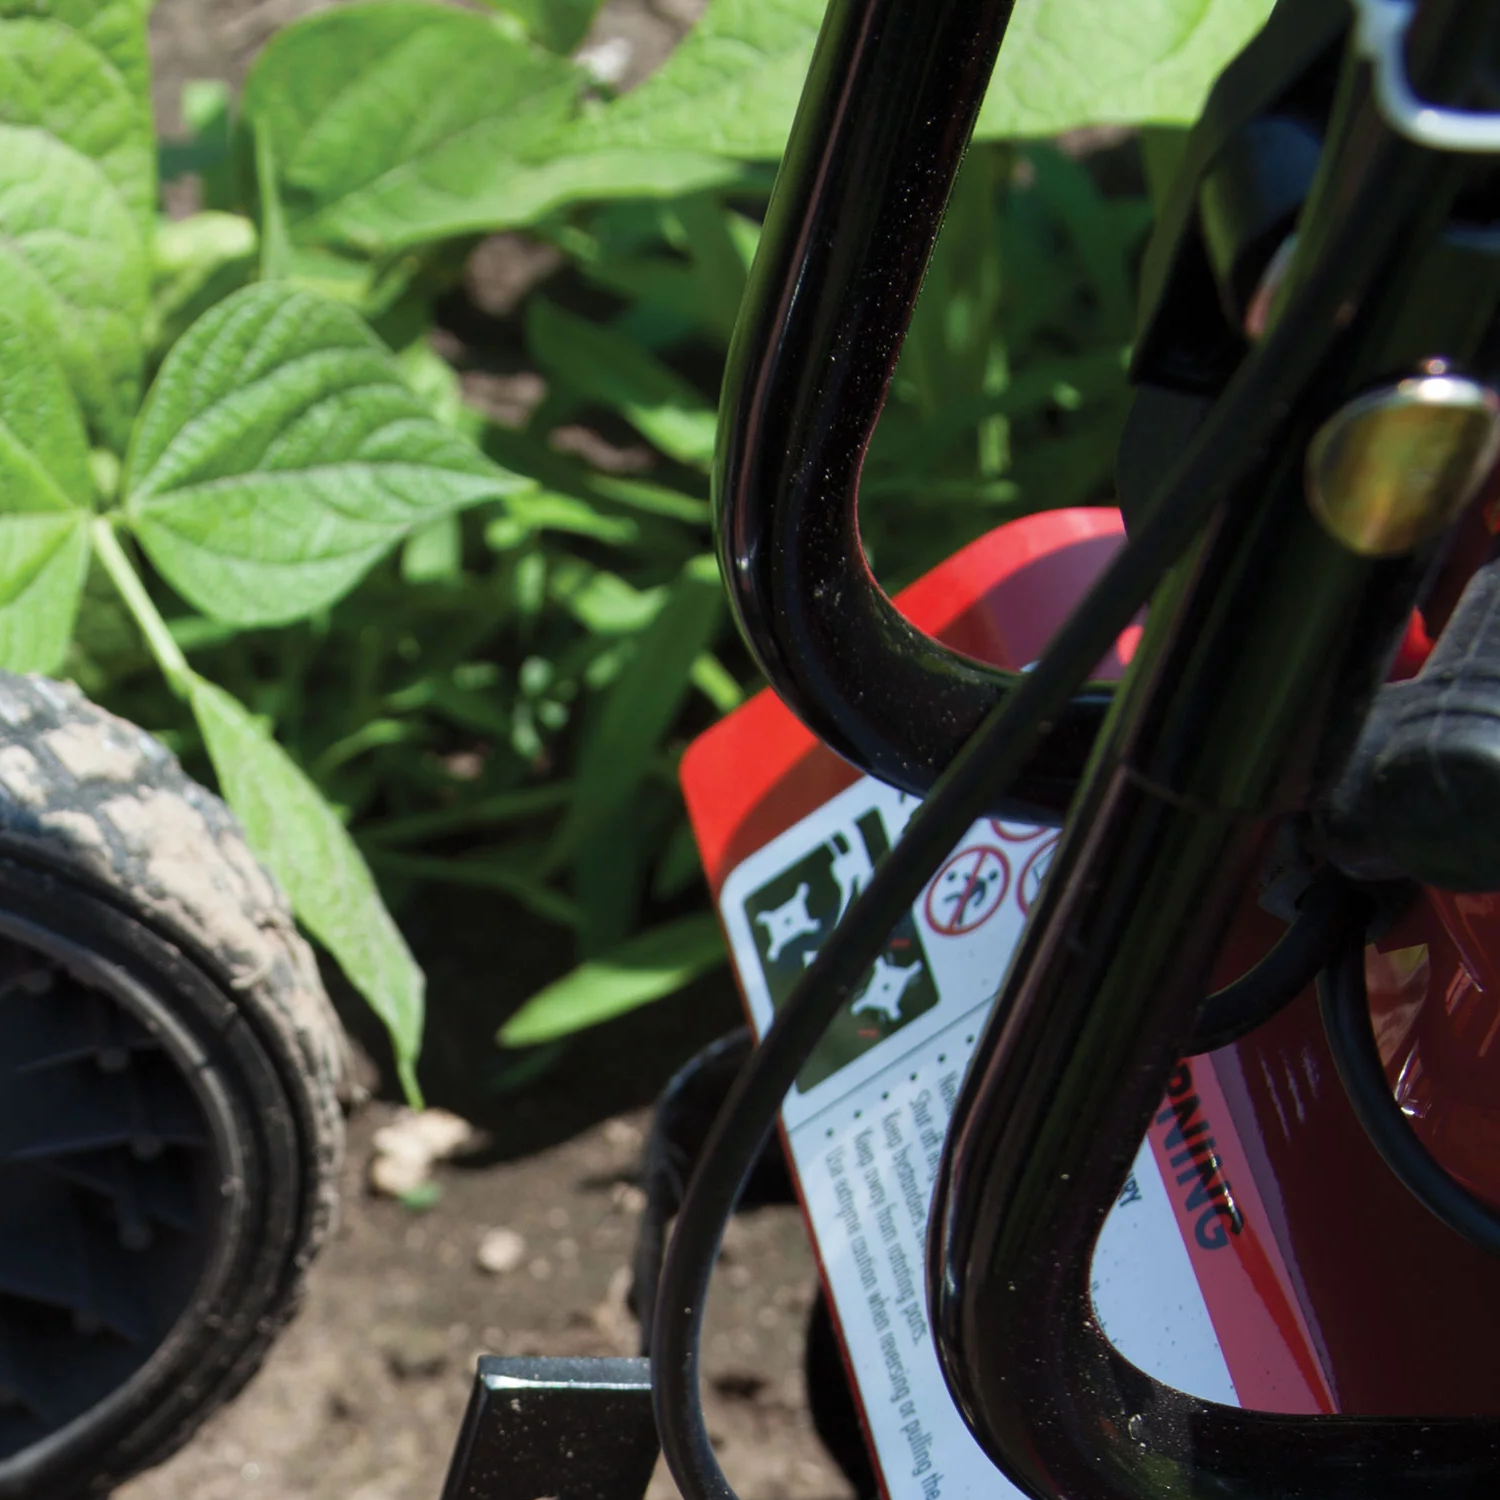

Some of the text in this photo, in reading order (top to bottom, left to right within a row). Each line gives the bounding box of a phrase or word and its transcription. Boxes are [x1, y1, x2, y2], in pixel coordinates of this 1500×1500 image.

[881, 1108, 903, 1149] Keep
[824, 1144, 844, 1179] Use
[890, 1143, 928, 1227] bystanders
[833, 1177, 862, 1236] extreme
[850, 1235, 879, 1292] caution
[853, 1126, 928, 1347] Keep away from rotating parts.
[867, 1290, 890, 1333] when
[879, 1331, 911, 1404] reversing
[898, 1400, 916, 1420] or
[899, 1418, 933, 1478] pulling
